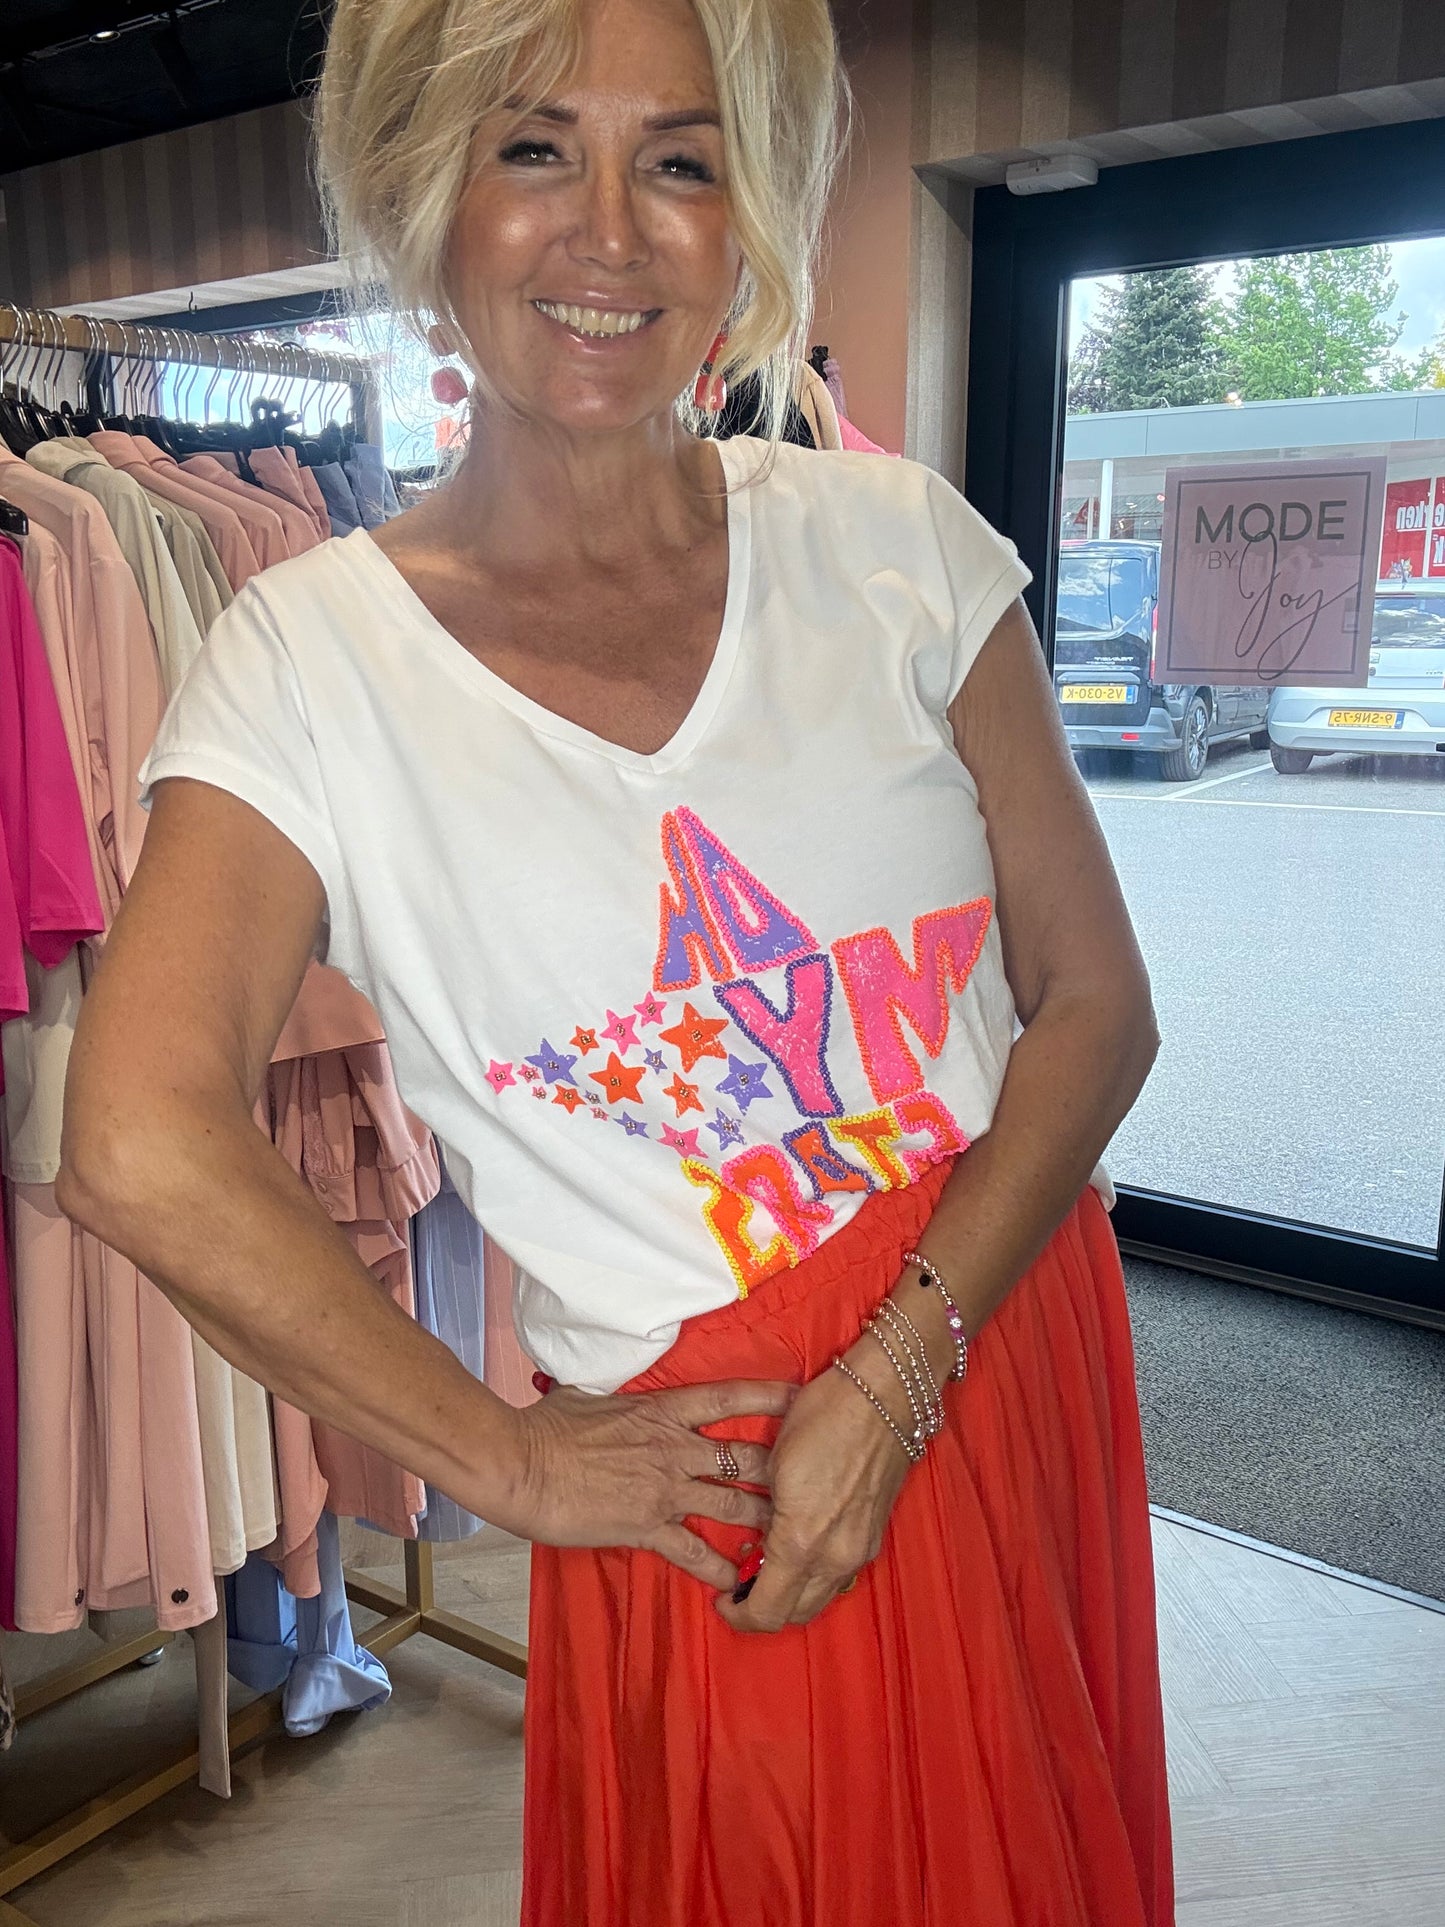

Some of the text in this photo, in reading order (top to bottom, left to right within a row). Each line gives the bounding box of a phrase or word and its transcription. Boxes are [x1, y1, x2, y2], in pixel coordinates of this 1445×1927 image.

[1193, 499, 1347, 544] MODE
[1207, 549, 1239, 570] BY
[1234, 530, 1359, 681] Joy
